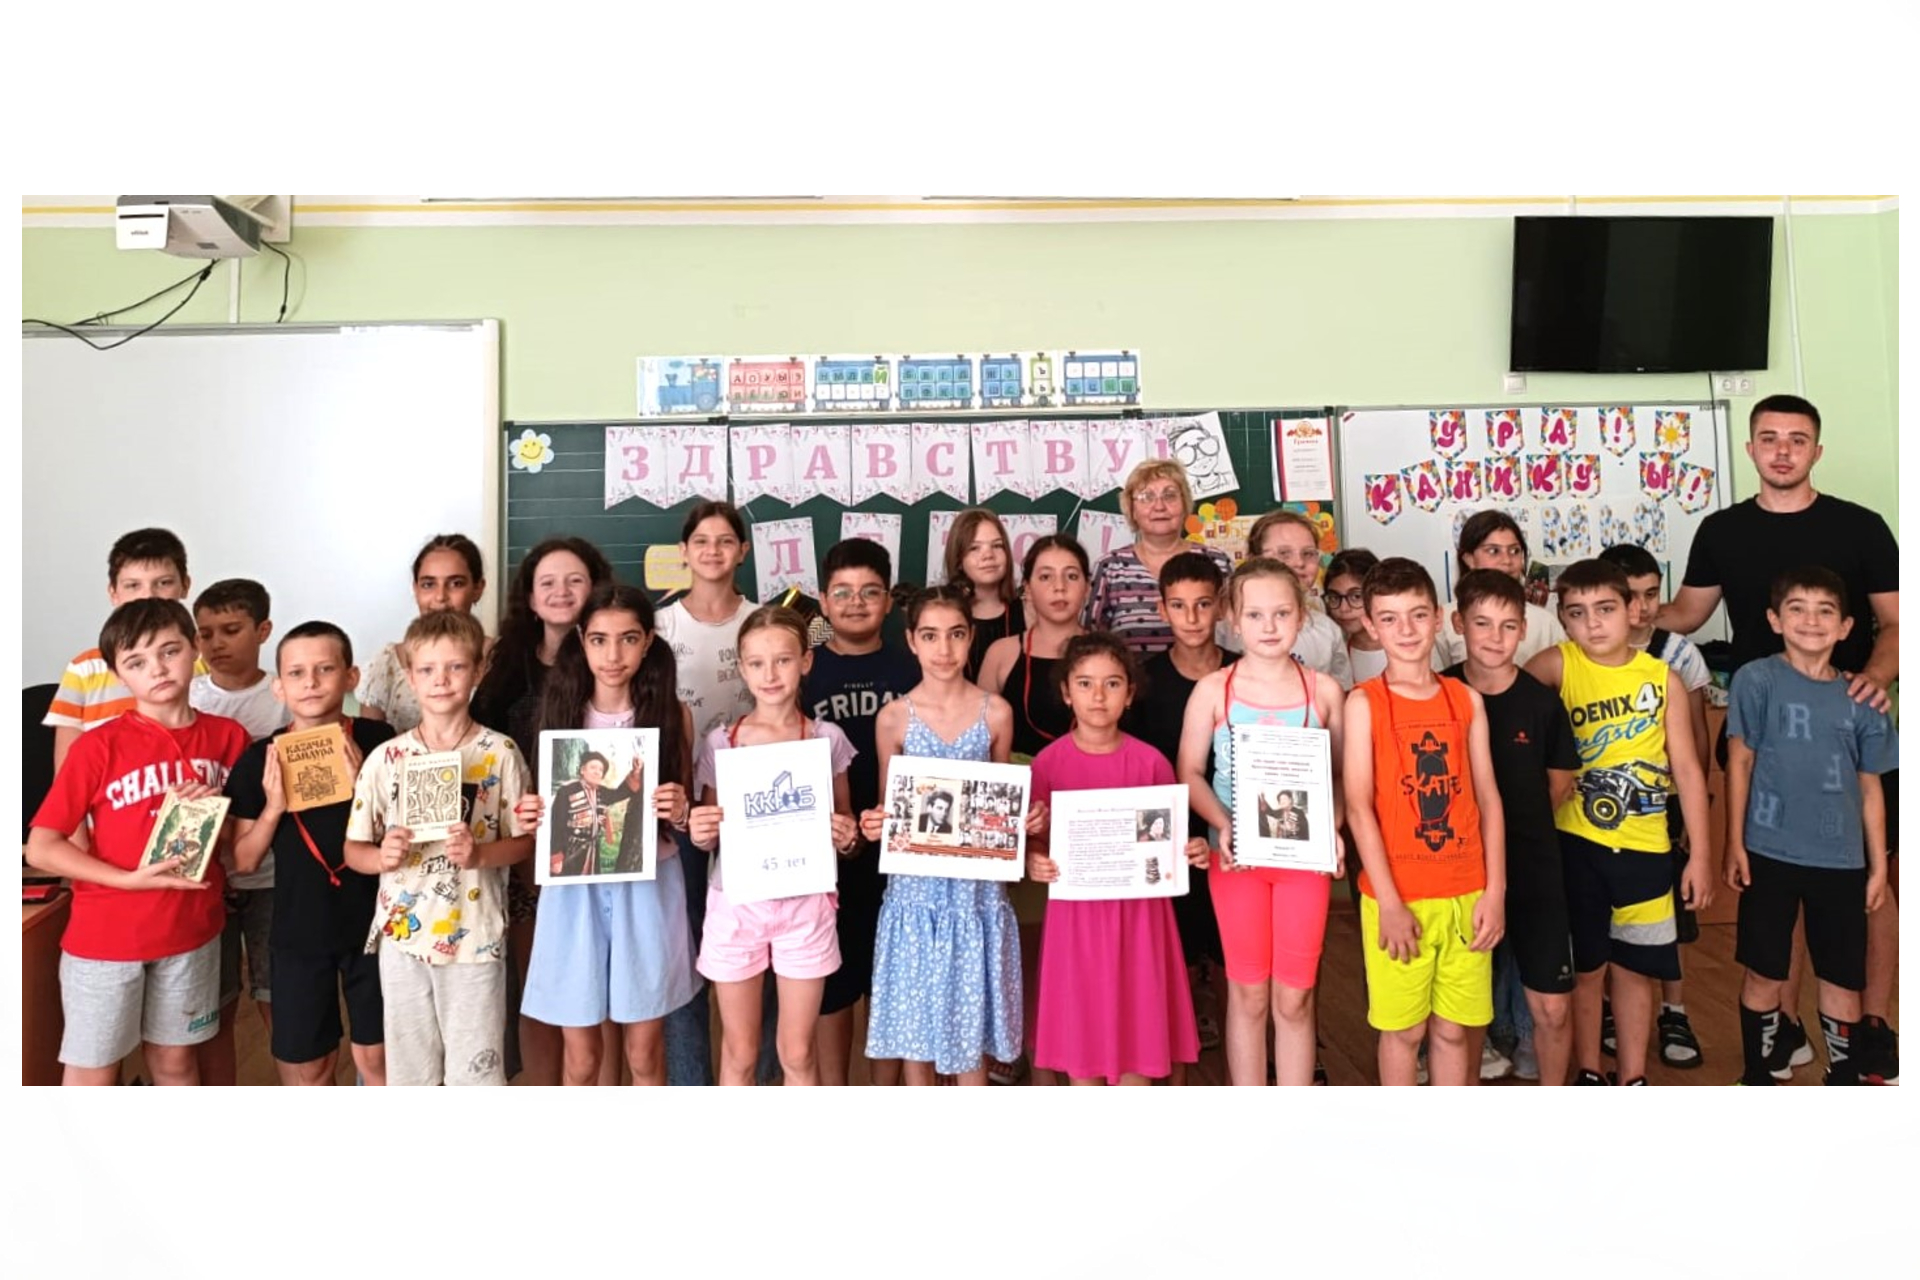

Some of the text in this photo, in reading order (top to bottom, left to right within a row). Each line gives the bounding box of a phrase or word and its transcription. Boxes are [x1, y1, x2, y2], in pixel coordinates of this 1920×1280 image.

[1437, 416, 1622, 448] УРА!
[1570, 694, 1634, 728] OENIX
[1401, 772, 1462, 797] SKATE
[761, 856, 779, 871] 45
